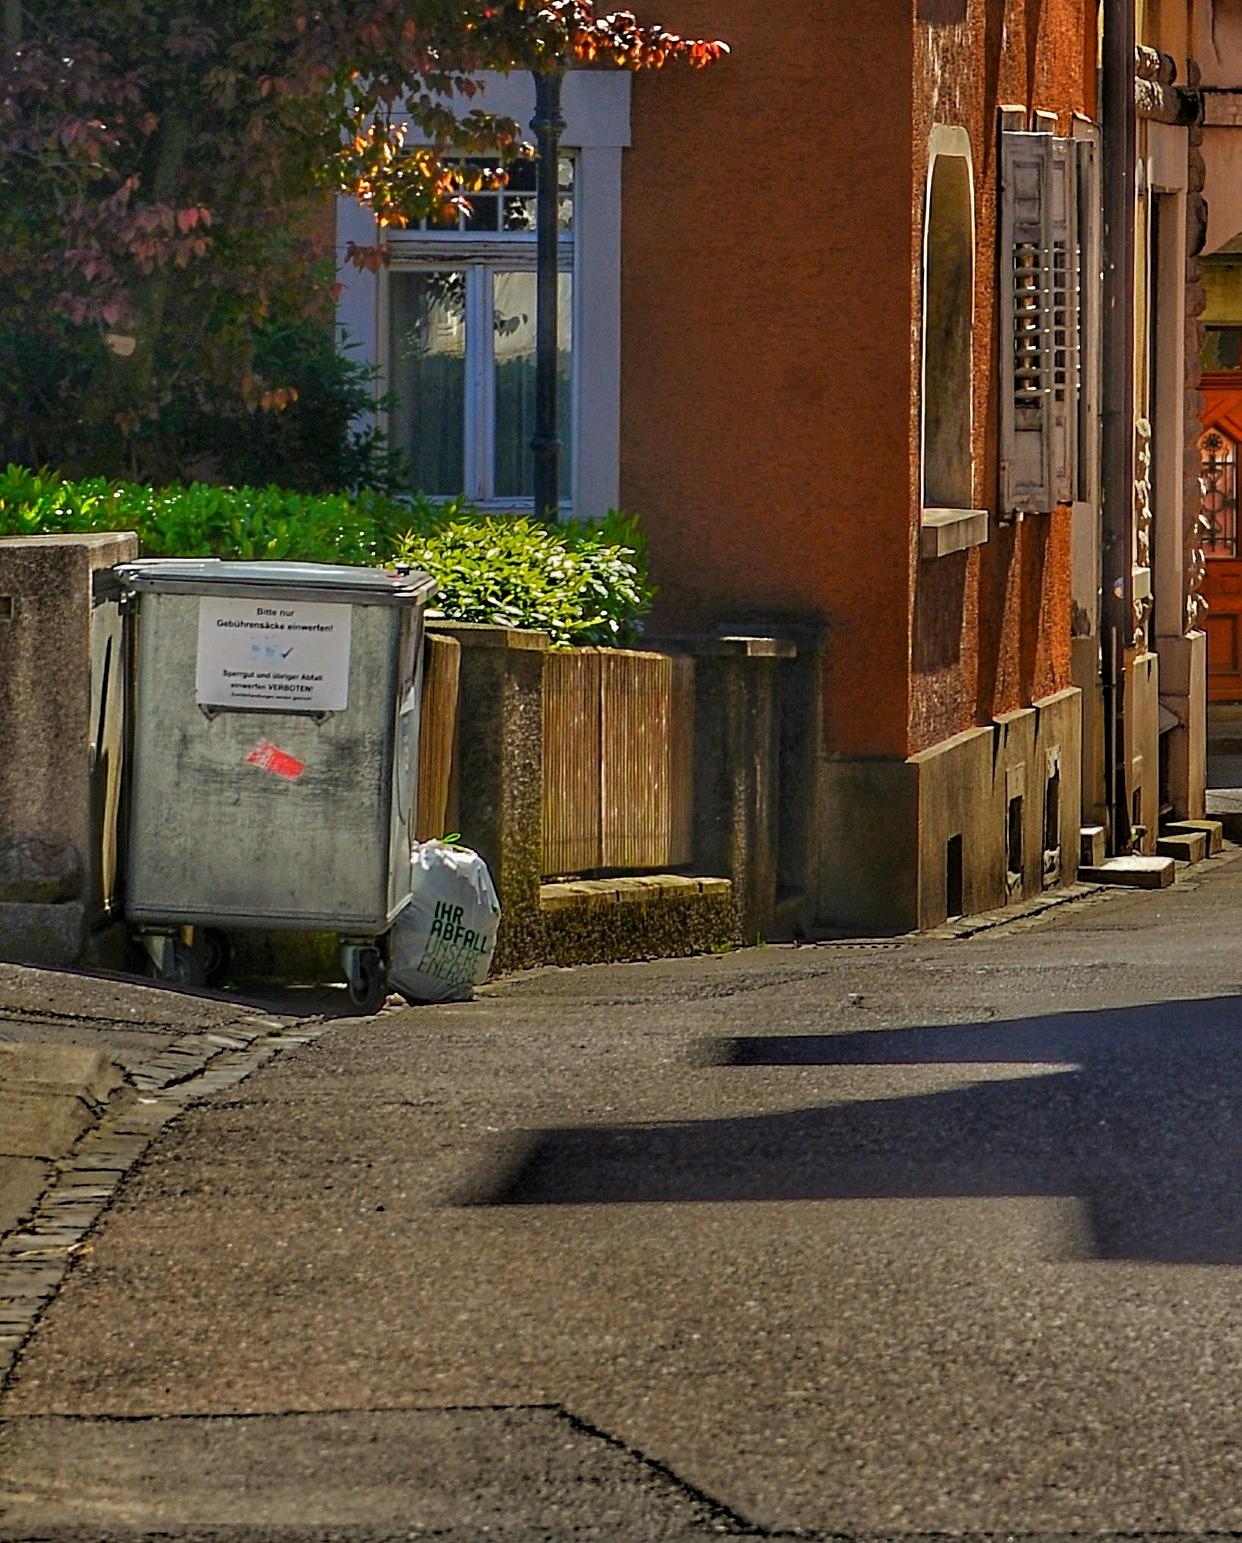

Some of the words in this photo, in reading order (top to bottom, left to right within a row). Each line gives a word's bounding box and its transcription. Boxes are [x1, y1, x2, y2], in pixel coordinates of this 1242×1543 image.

[257, 608, 277, 616] Bitte
[217, 619, 285, 630] Gebührensäcke
[288, 623, 334, 632] einwerfen!
[223, 669, 255, 679] Sperrgut
[272, 673, 299, 681] übriger
[300, 673, 323, 681] Abfall
[268, 684, 314, 692] VERBOTEN!
[434, 900, 464, 925] IHR
[430, 919, 487, 954] ABFALL
[425, 935, 482, 971] UNSERE
